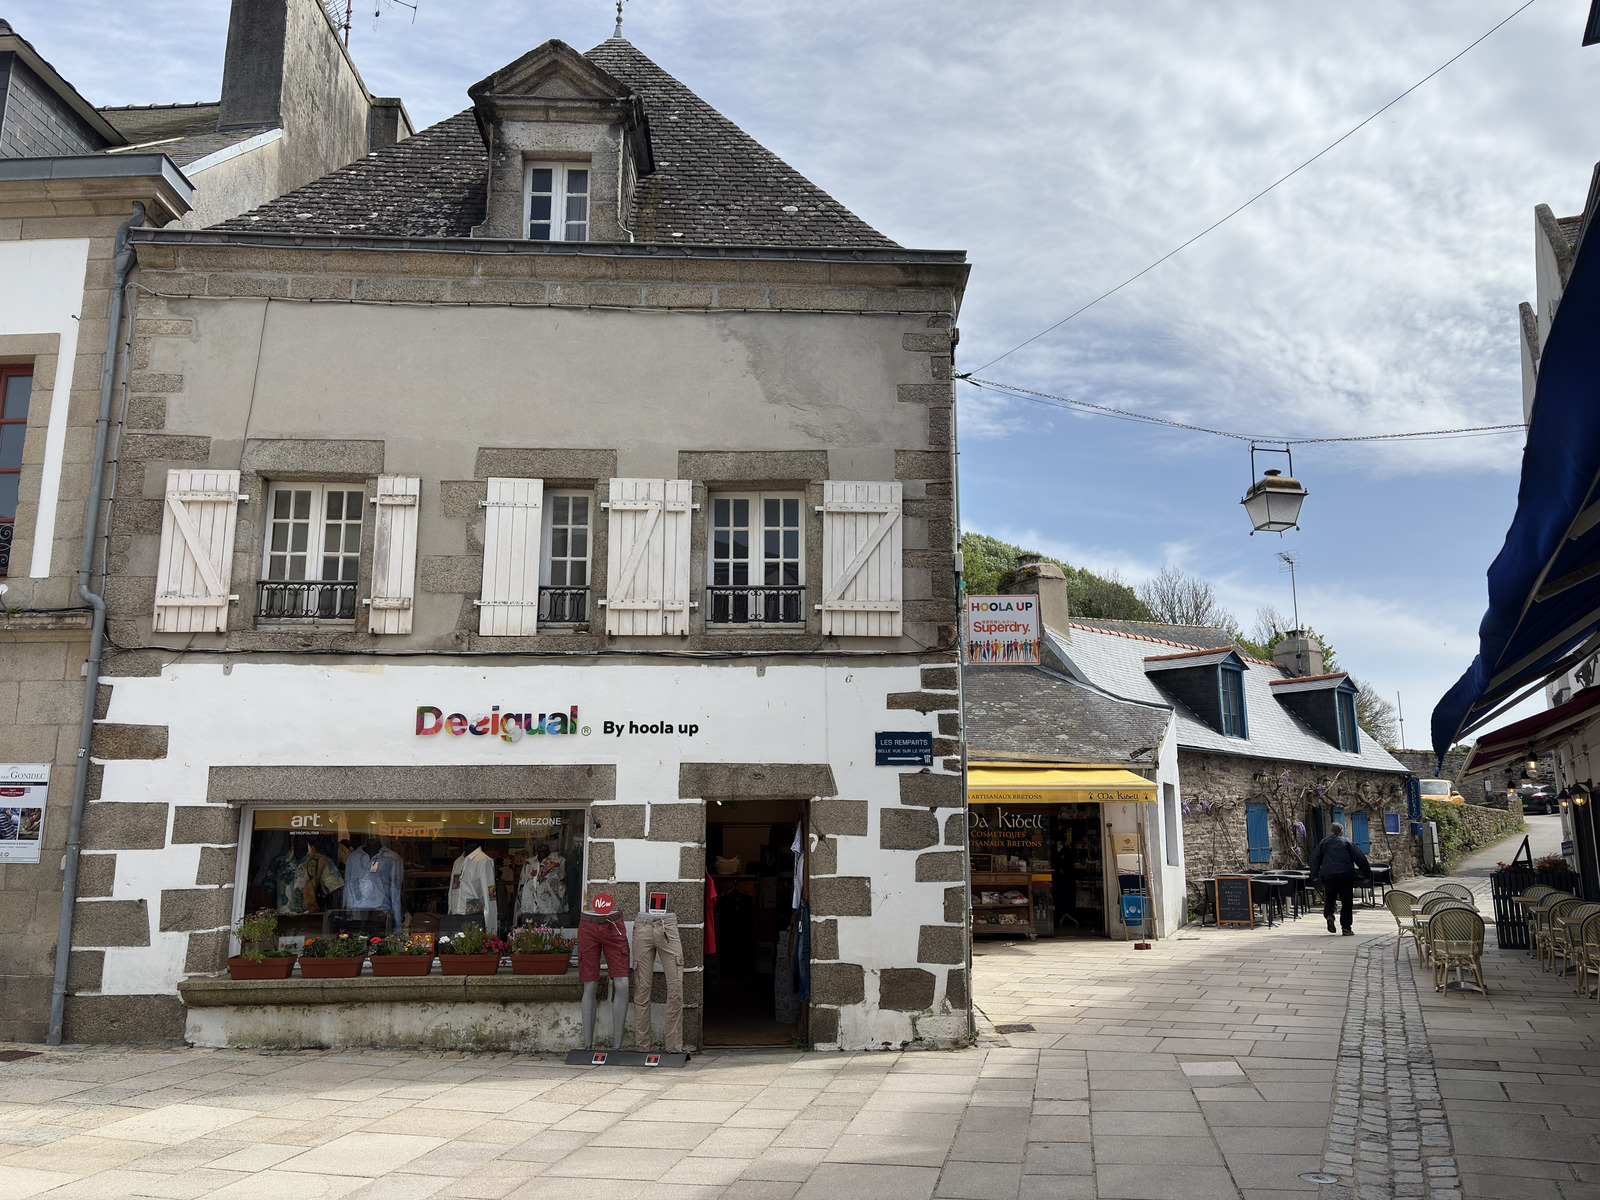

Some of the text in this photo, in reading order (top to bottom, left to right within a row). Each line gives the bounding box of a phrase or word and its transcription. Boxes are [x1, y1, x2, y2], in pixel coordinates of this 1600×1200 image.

[971, 602, 1033, 612] HOOLA UP
[415, 705, 578, 743] Desigual
[603, 720, 699, 737] By hoola up
[1097, 792, 1114, 800] Ma
[515, 817, 561, 826] TIMEZONE
[997, 806, 1043, 829] Kibell
[970, 830, 1026, 839] COSMETIQUES
[595, 898, 611, 908] New
